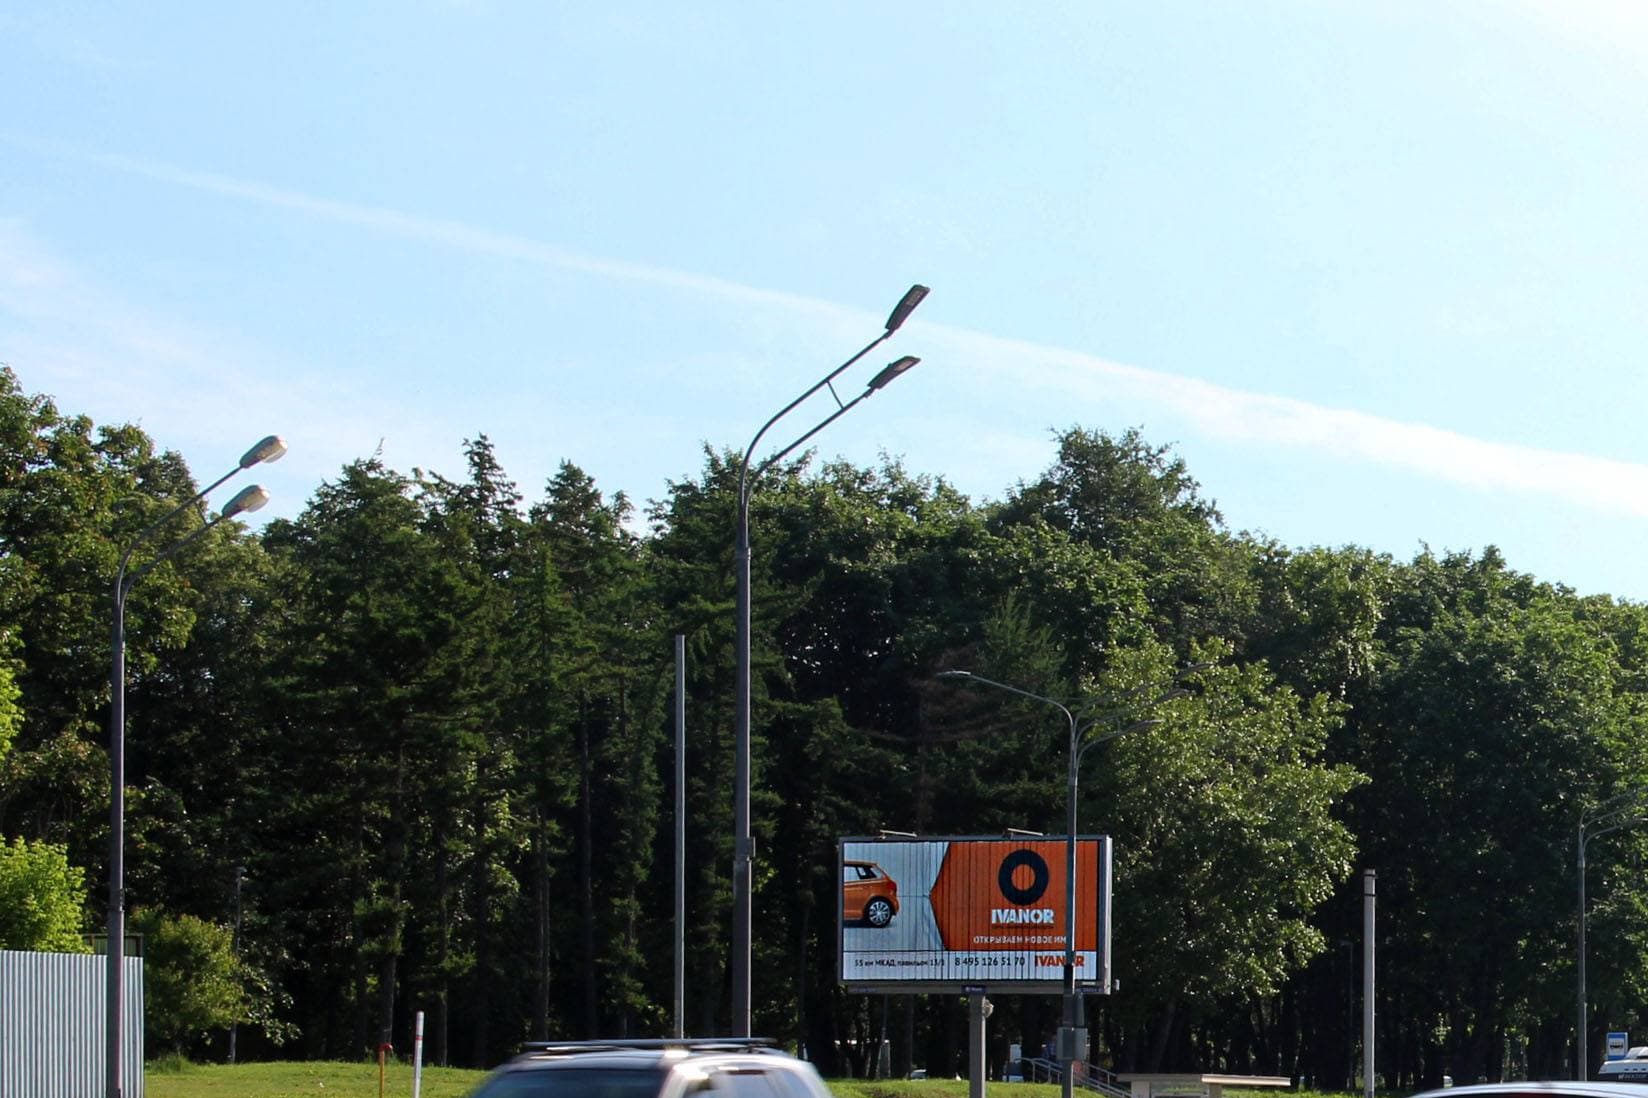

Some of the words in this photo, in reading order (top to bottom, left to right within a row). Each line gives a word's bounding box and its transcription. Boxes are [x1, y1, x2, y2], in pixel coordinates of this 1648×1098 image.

[991, 908, 1054, 924] IVANOR
[954, 957, 960, 966] 8
[962, 957, 979, 966] 495
[982, 957, 999, 966] 126
[1001, 957, 1011, 966] 51
[1014, 957, 1025, 966] 70
[1034, 955, 1085, 967] IVANR
